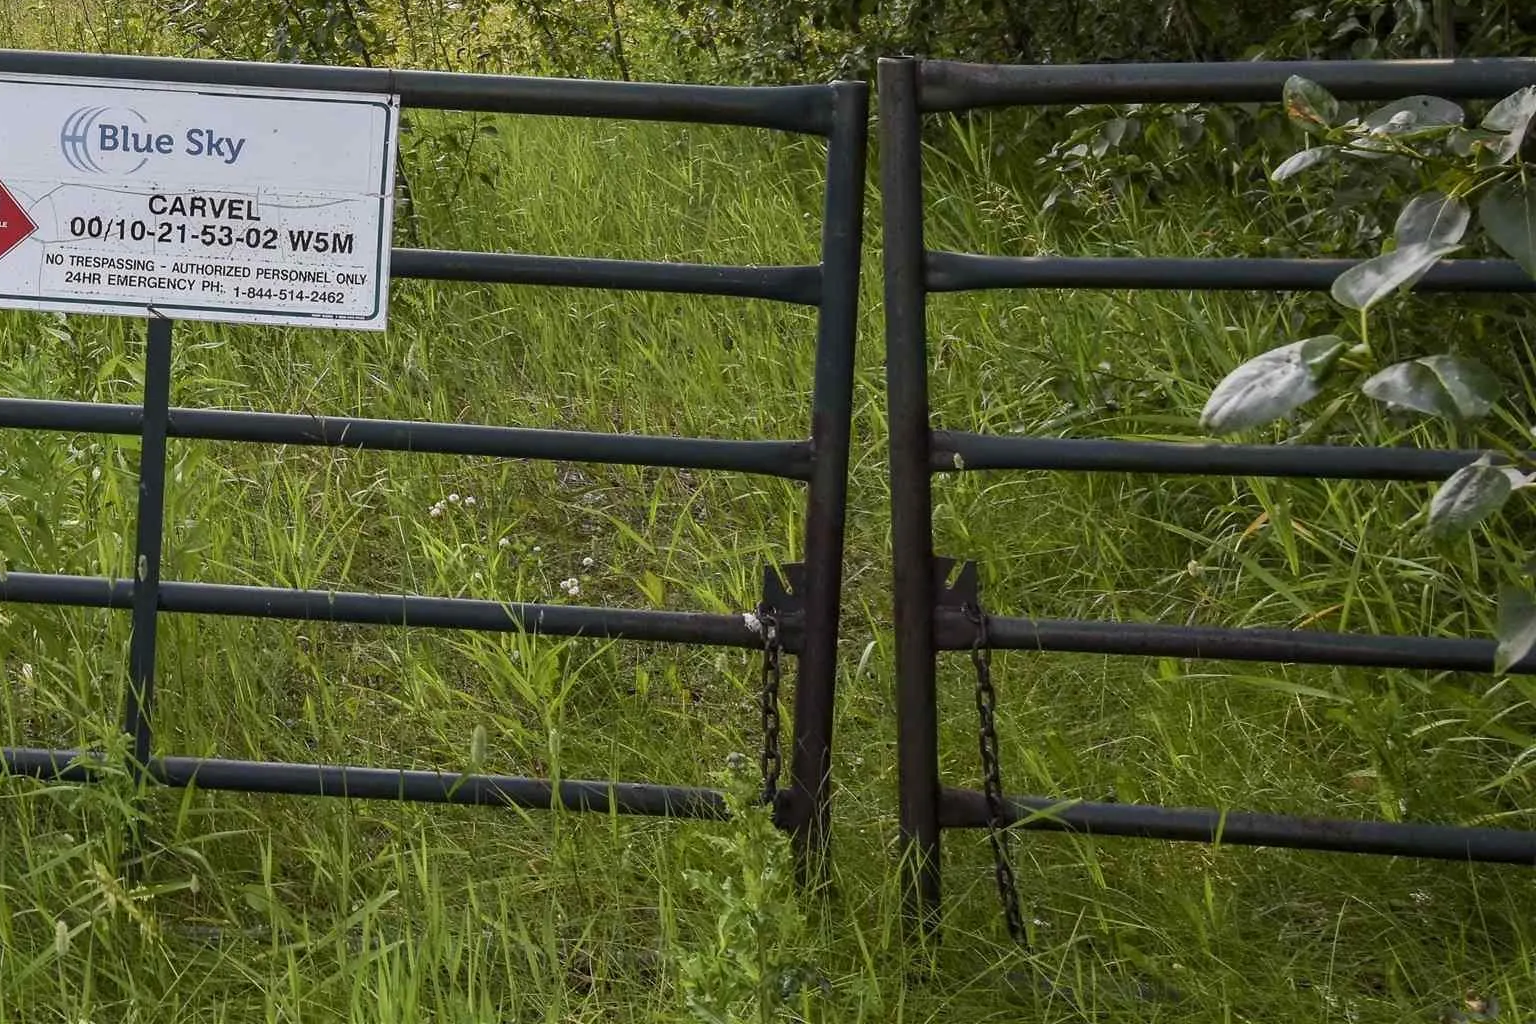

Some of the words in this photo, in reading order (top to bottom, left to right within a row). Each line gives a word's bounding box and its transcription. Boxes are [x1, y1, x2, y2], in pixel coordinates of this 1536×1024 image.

[99, 124, 174, 154] Blue
[185, 128, 246, 164] Sky
[148, 195, 261, 221] CARVEL
[70, 216, 278, 249] 00/10-21-53-02
[288, 230, 354, 254] W5M
[45, 253, 64, 265] NO
[69, 255, 155, 271] TRESPASSING
[171, 262, 251, 278] AUTHORIZED
[256, 268, 331, 284] PERSONNEL
[336, 273, 368, 285] ONLY
[65, 271, 101, 285] 24HR
[107, 274, 195, 290] EMERGENCY
[233, 286, 344, 304] 1-844-514-2462
